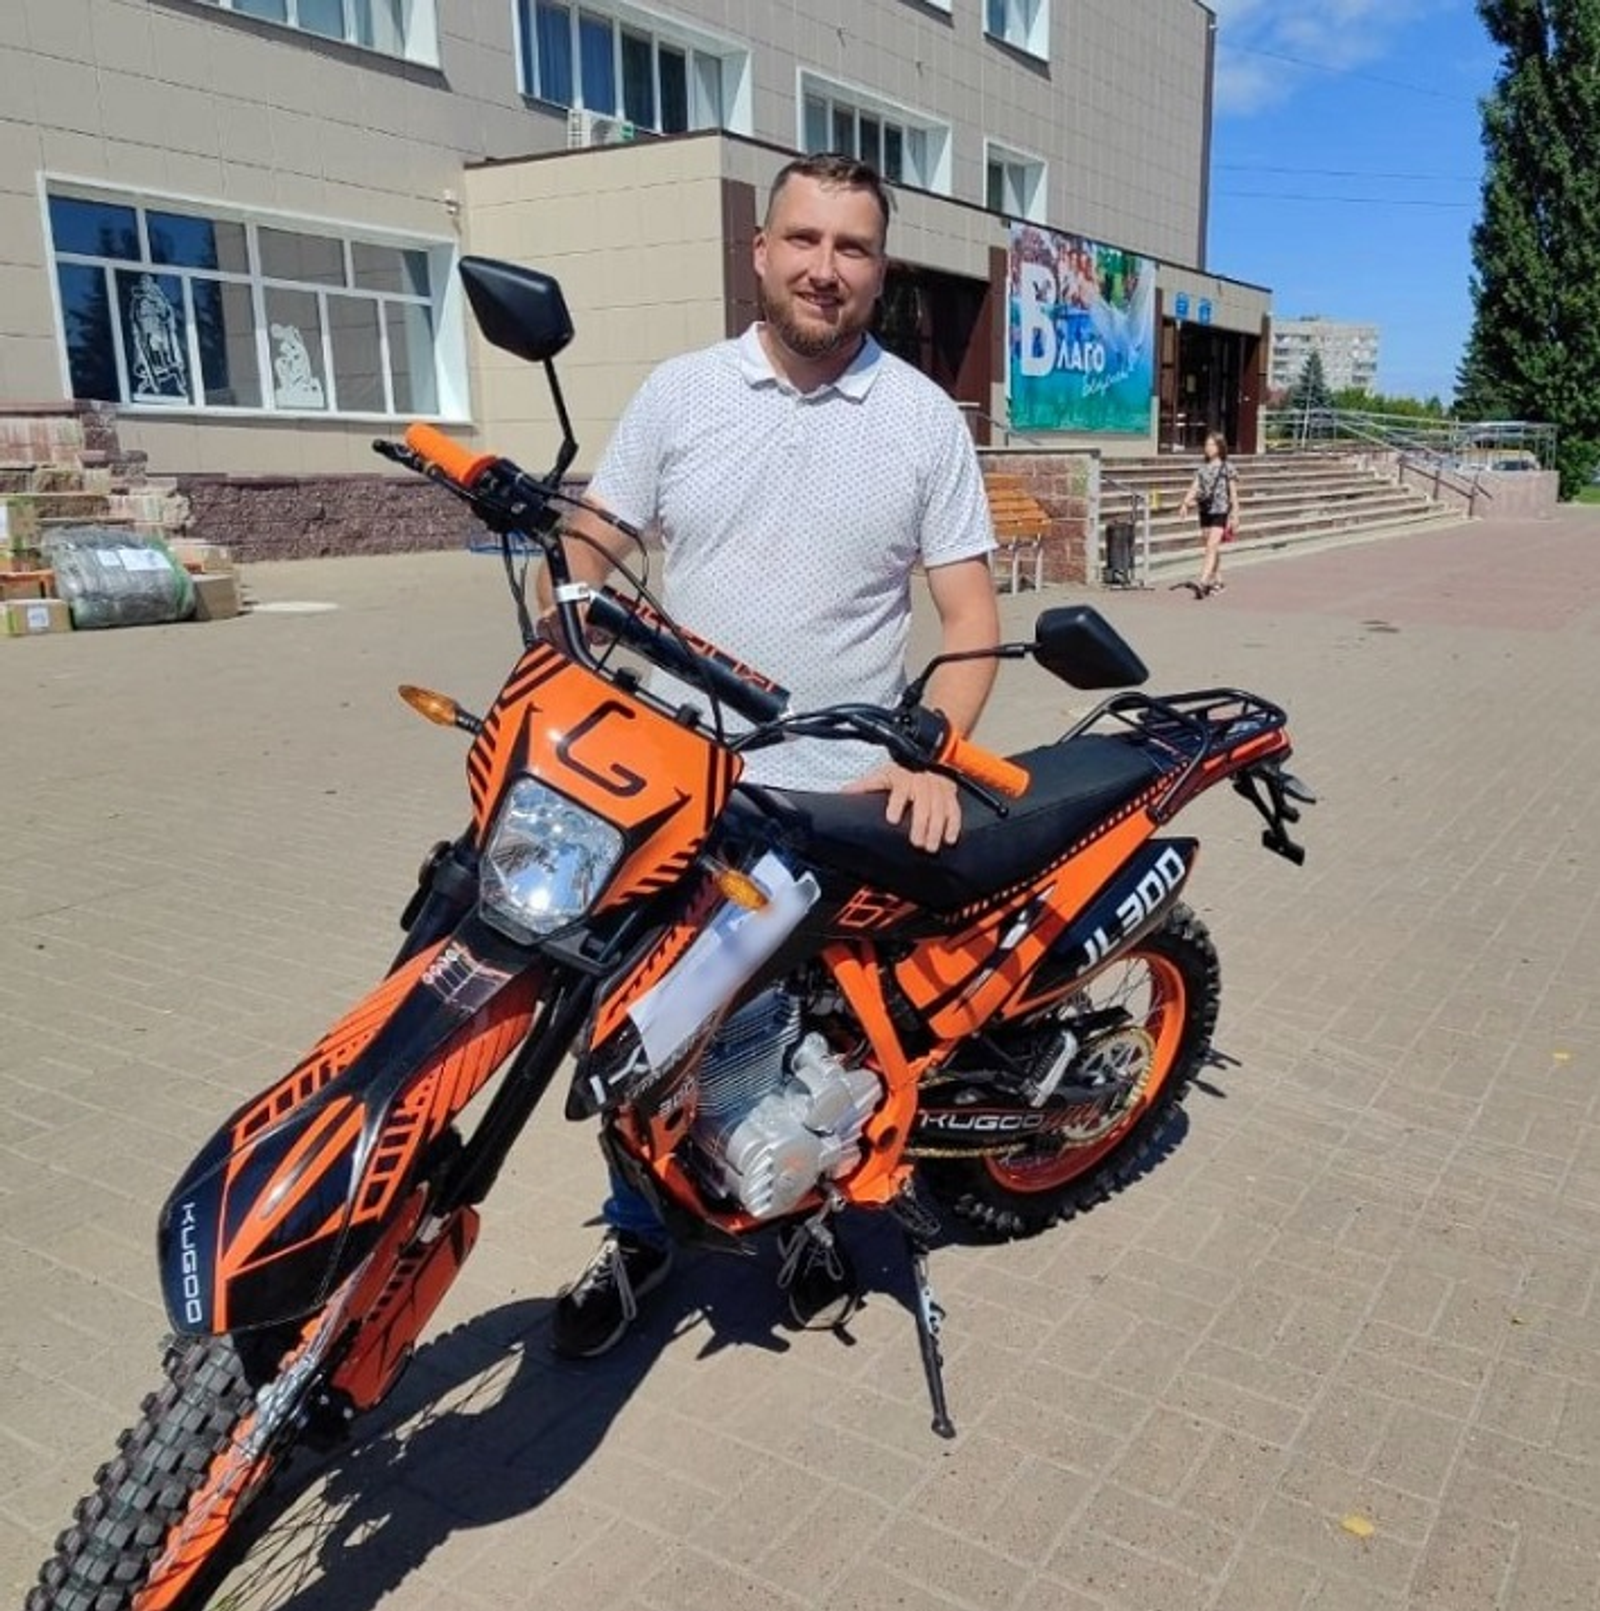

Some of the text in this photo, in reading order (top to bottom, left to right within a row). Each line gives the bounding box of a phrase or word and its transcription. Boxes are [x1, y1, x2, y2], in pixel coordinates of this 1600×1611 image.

[1077, 847, 1186, 976] JL300
[918, 1109, 1045, 1131] KUGOO
[181, 1202, 203, 1324] KUGOO
